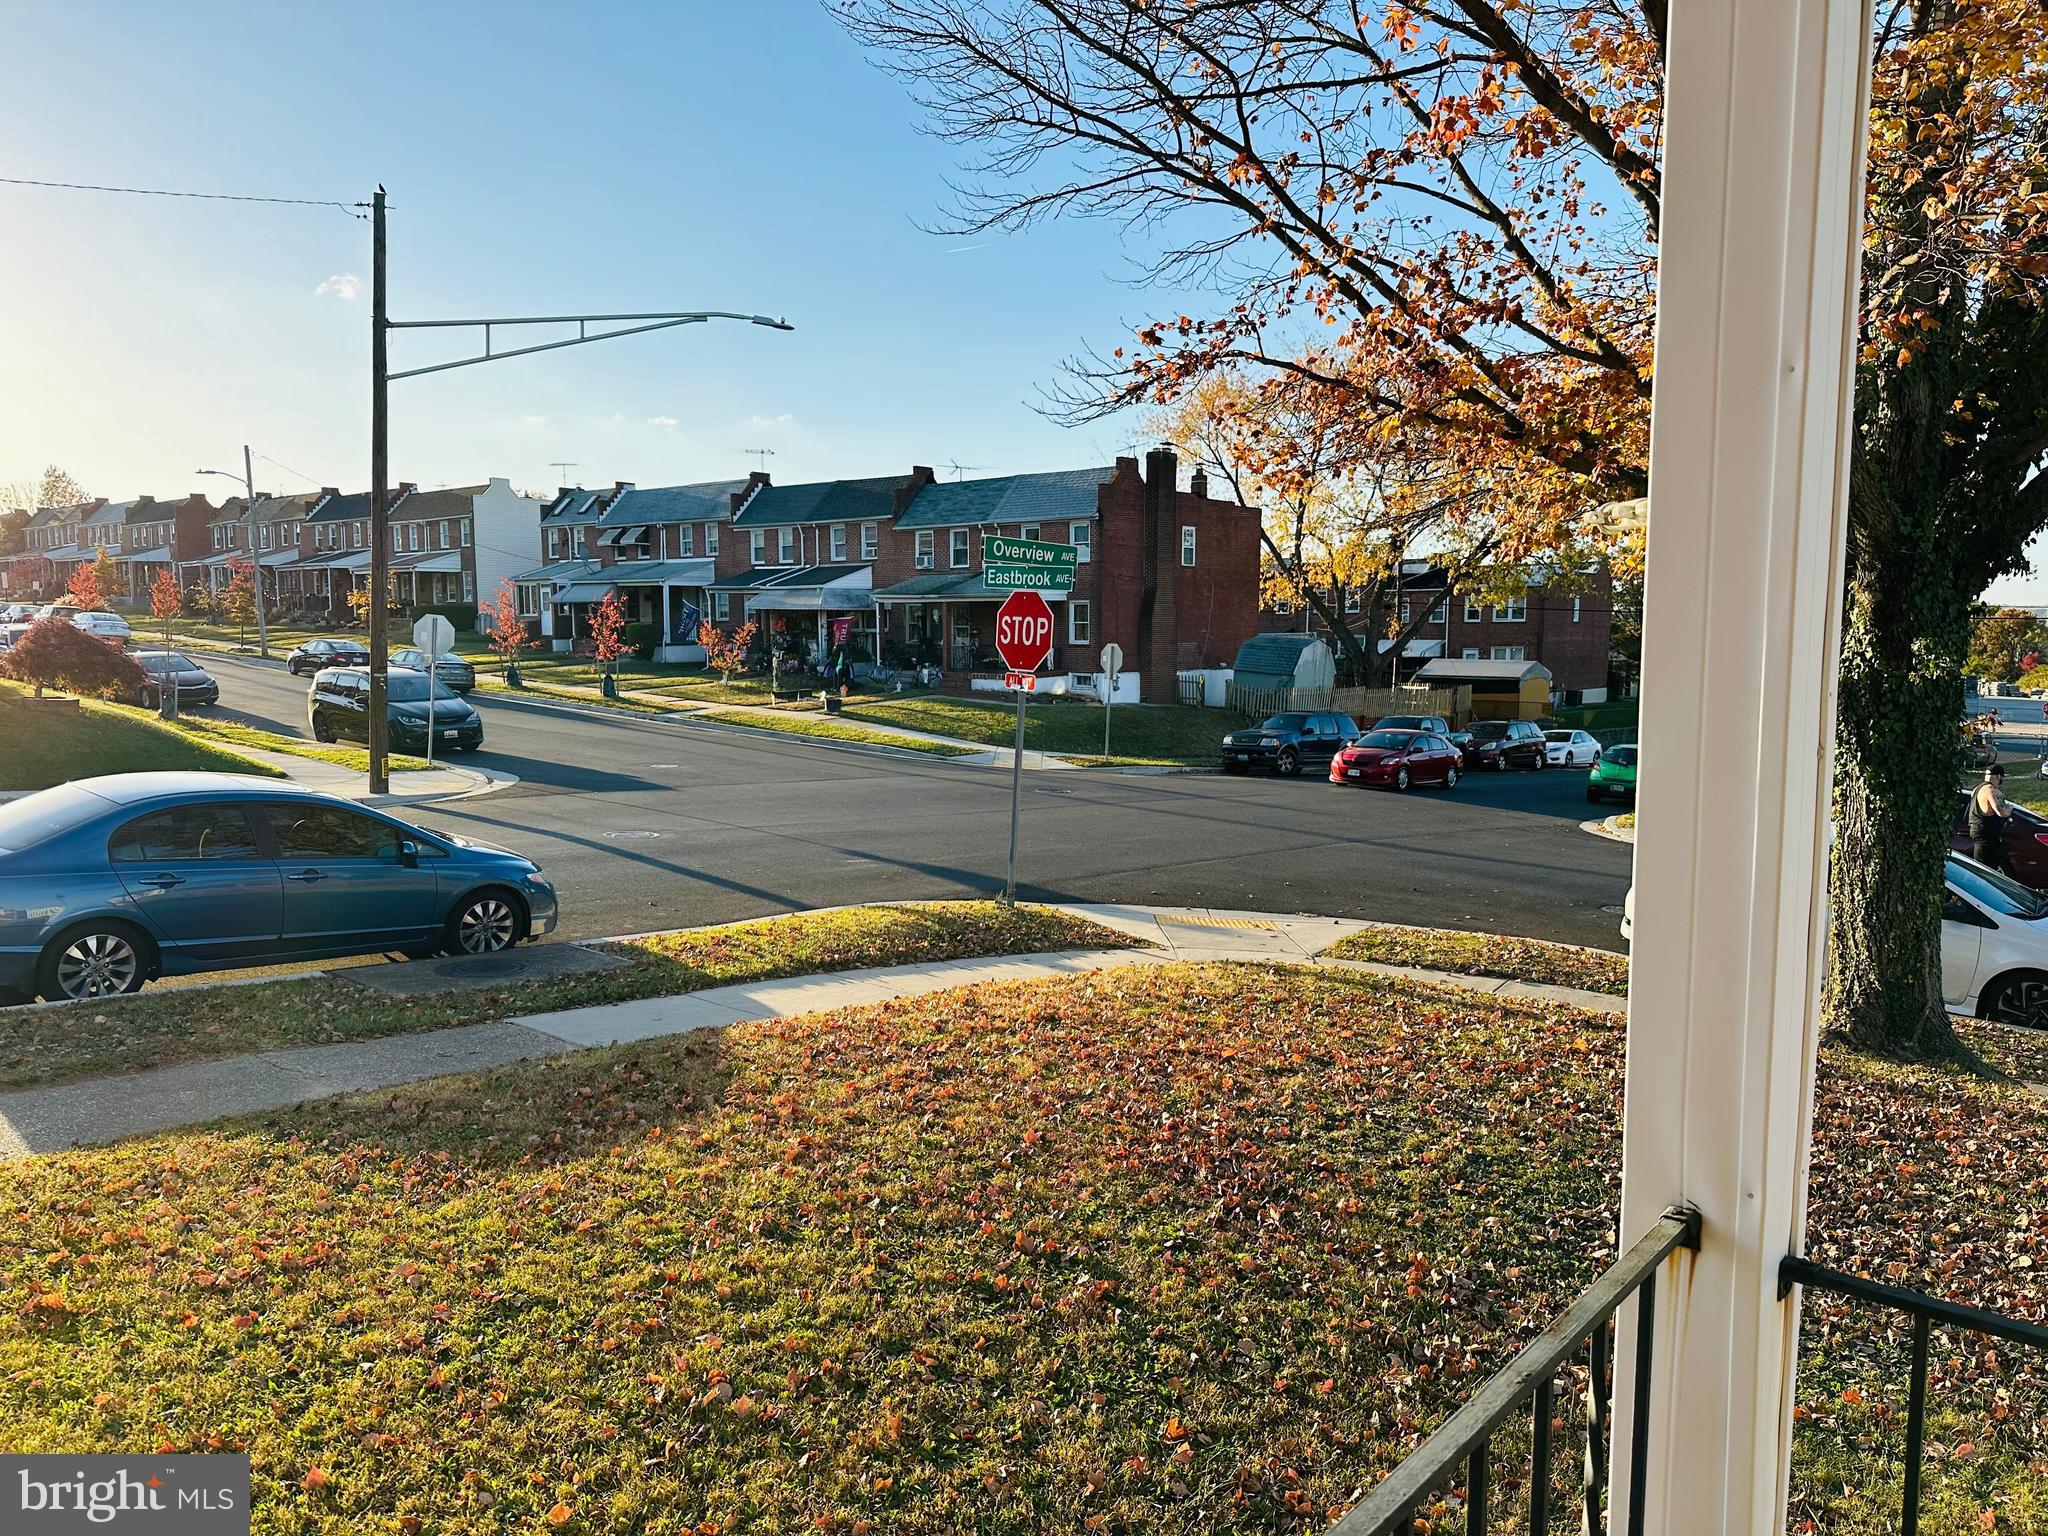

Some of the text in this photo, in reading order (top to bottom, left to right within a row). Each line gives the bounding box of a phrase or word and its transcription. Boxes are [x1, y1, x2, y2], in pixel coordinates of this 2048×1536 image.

[993, 540, 1075, 562] Overview AVE
[987, 569, 1070, 586] Eastbrook AVE
[1000, 615, 1049, 646] STOP
